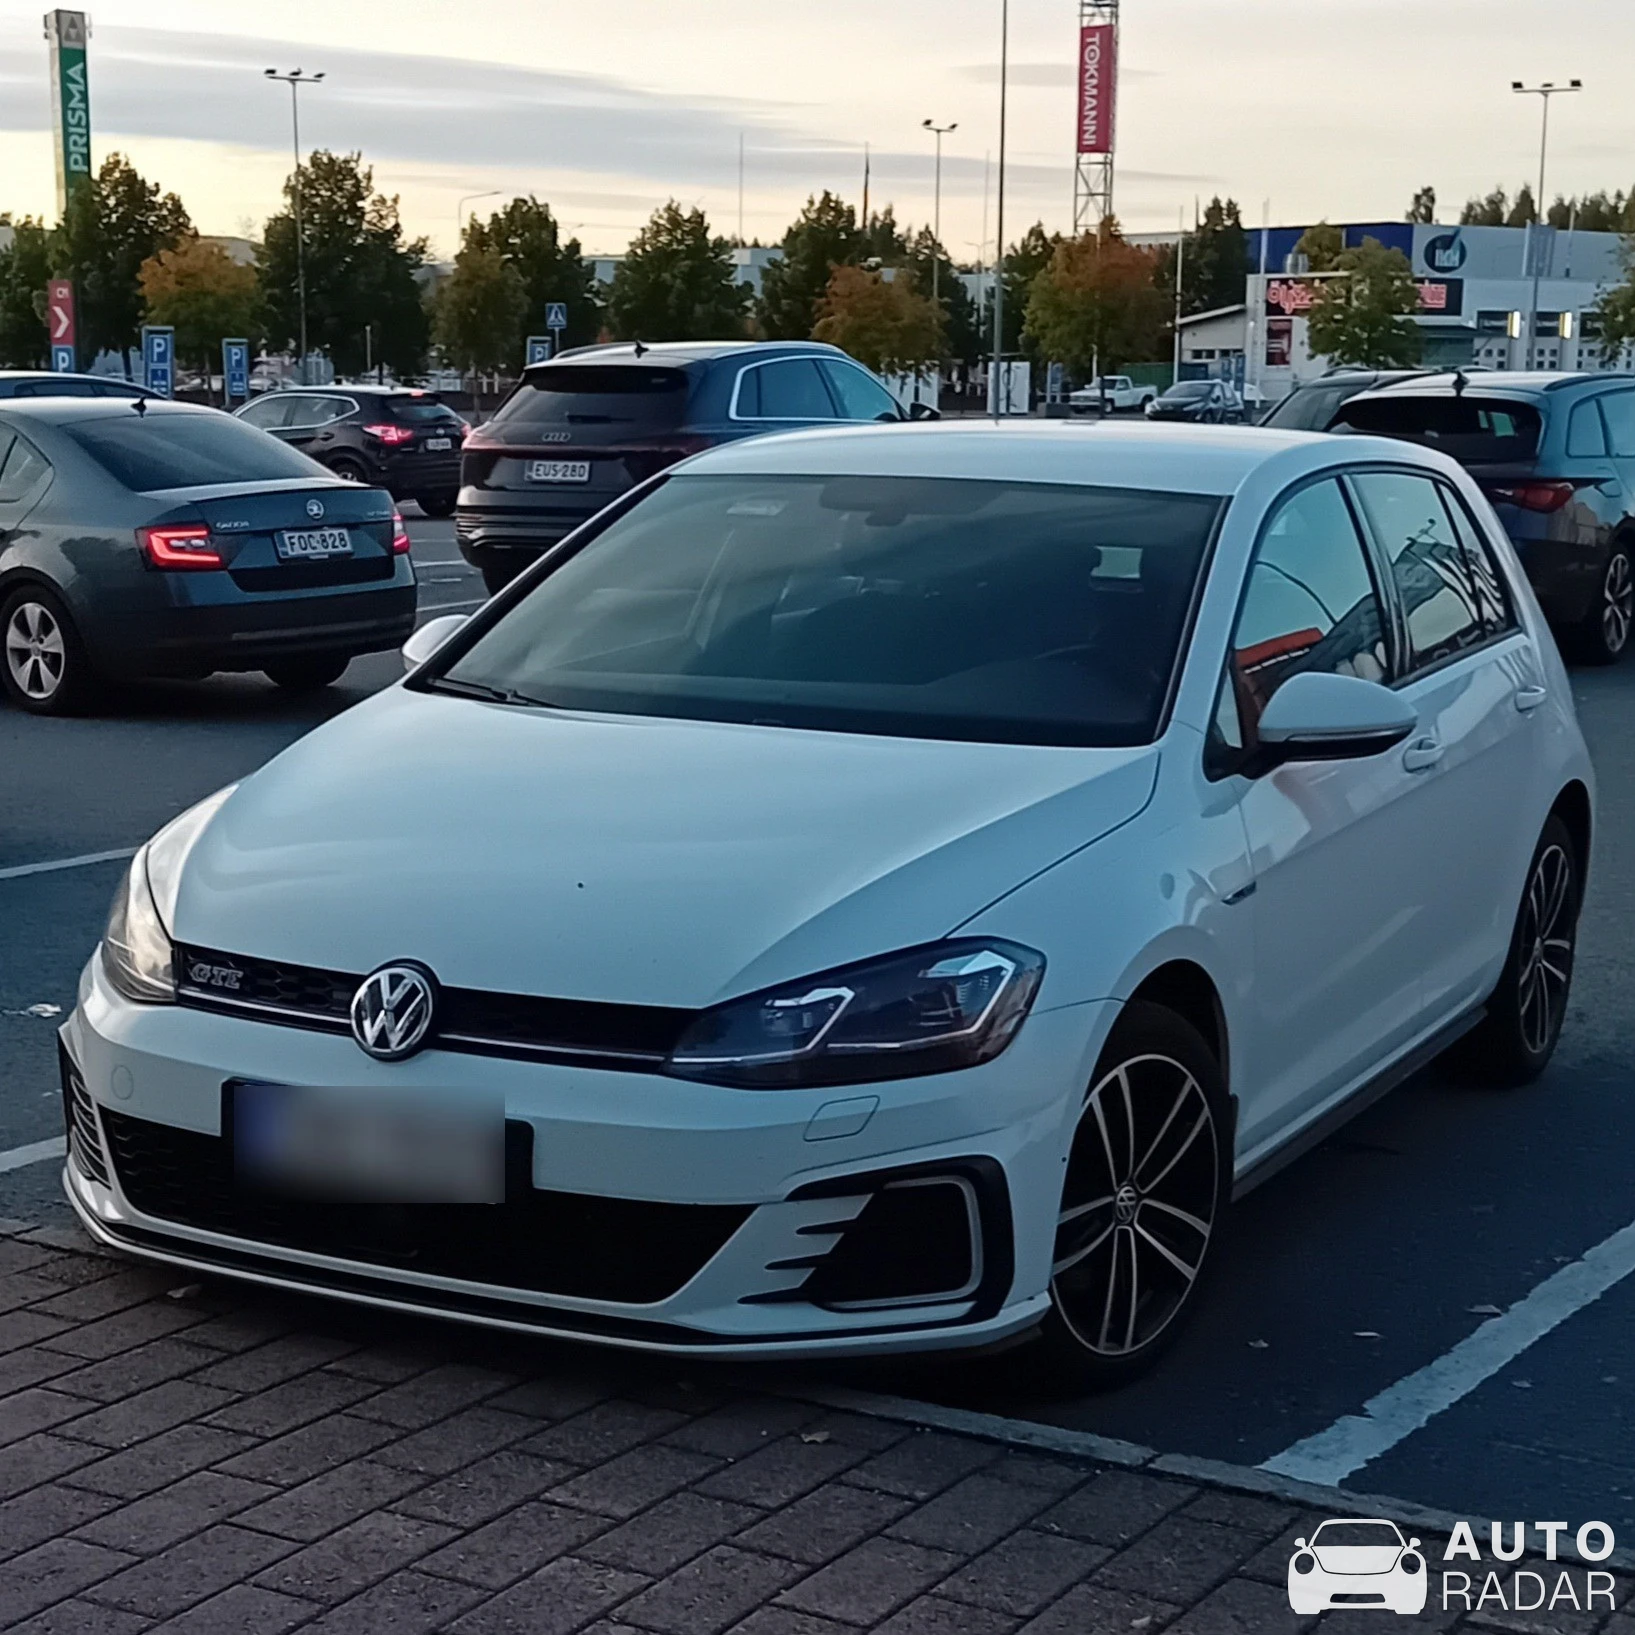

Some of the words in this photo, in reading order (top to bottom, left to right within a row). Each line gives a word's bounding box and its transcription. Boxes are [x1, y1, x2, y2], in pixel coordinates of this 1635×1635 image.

[1082, 31, 1101, 146] TOKMANNI
[66, 62, 88, 172] PRISMA
[153, 338, 166, 361] P
[231, 348, 242, 367] P
[190, 963, 245, 989] GTE
